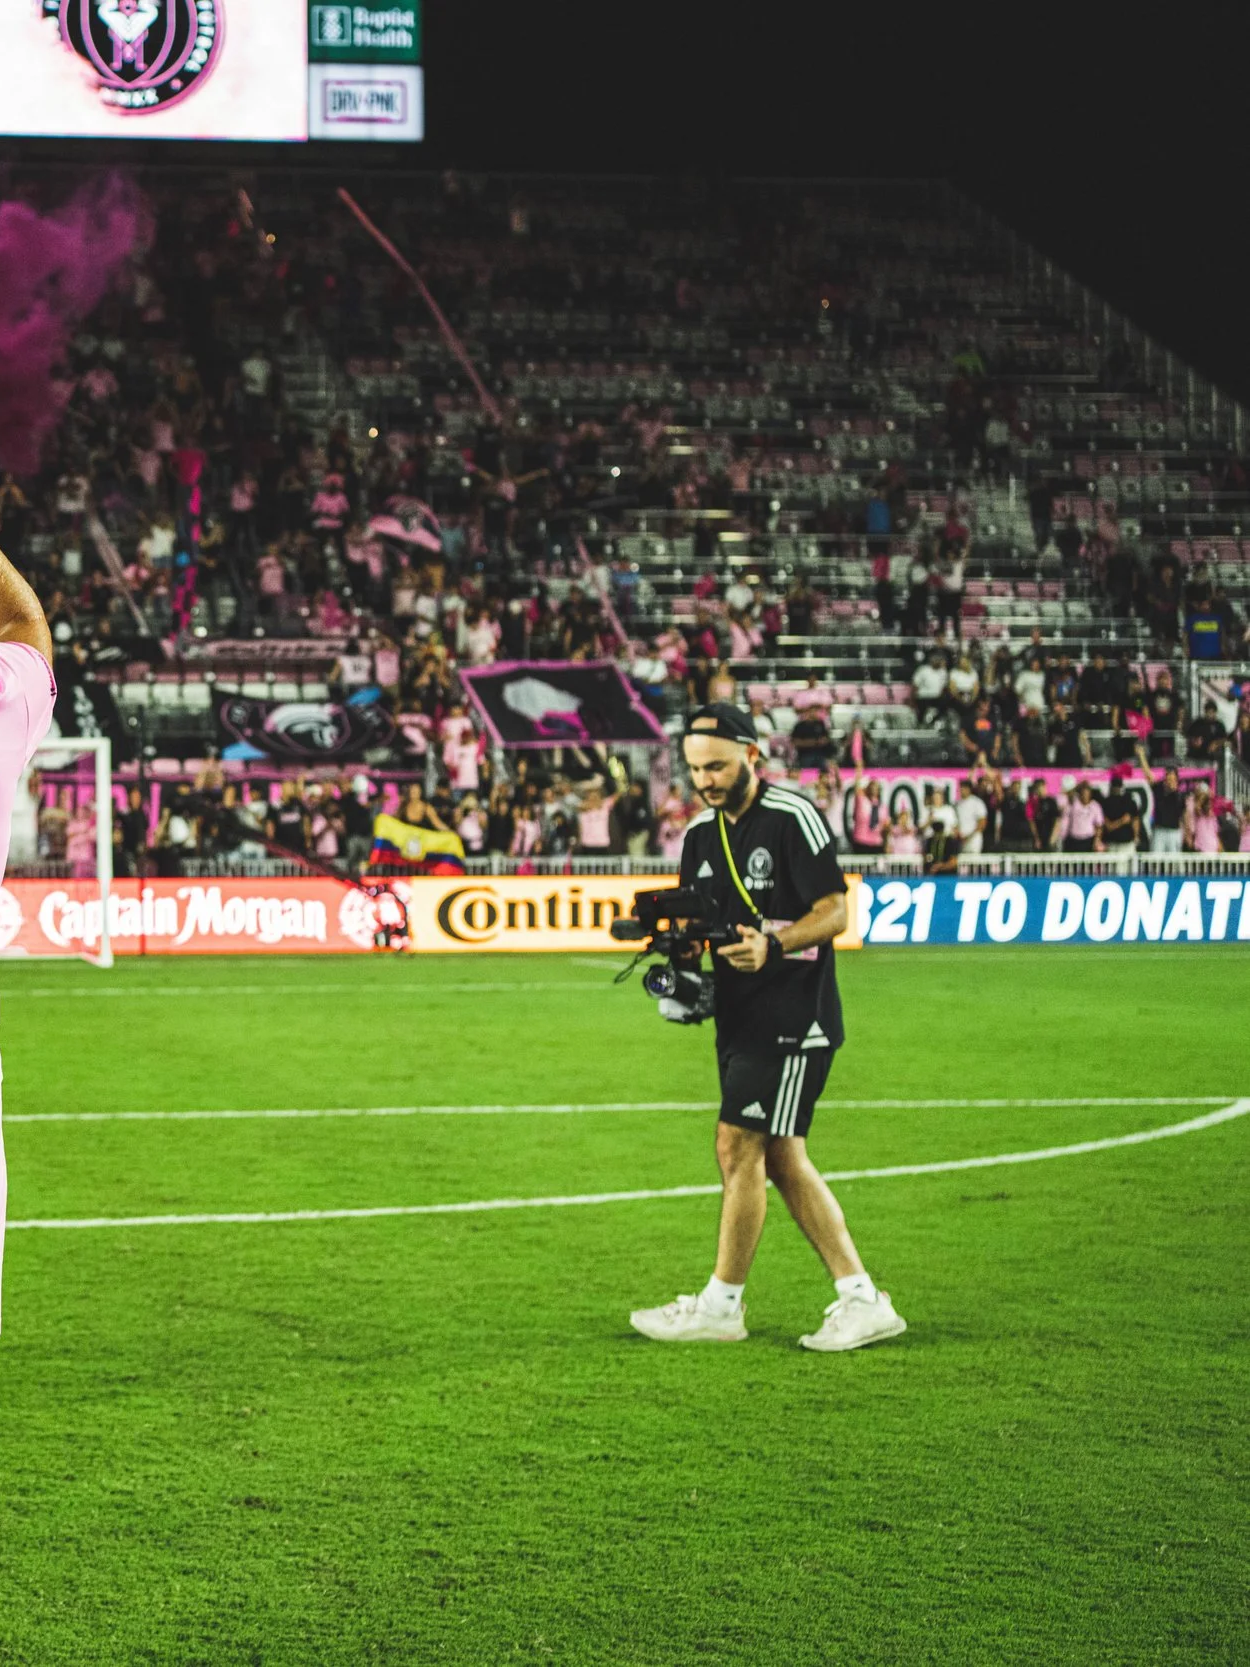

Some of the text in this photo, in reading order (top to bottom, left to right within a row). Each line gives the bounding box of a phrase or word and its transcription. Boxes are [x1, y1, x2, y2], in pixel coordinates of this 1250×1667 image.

[38, 885, 327, 947] Captain Morgan
[436, 886, 635, 943] Contin
[953, 880, 1028, 943] TO
